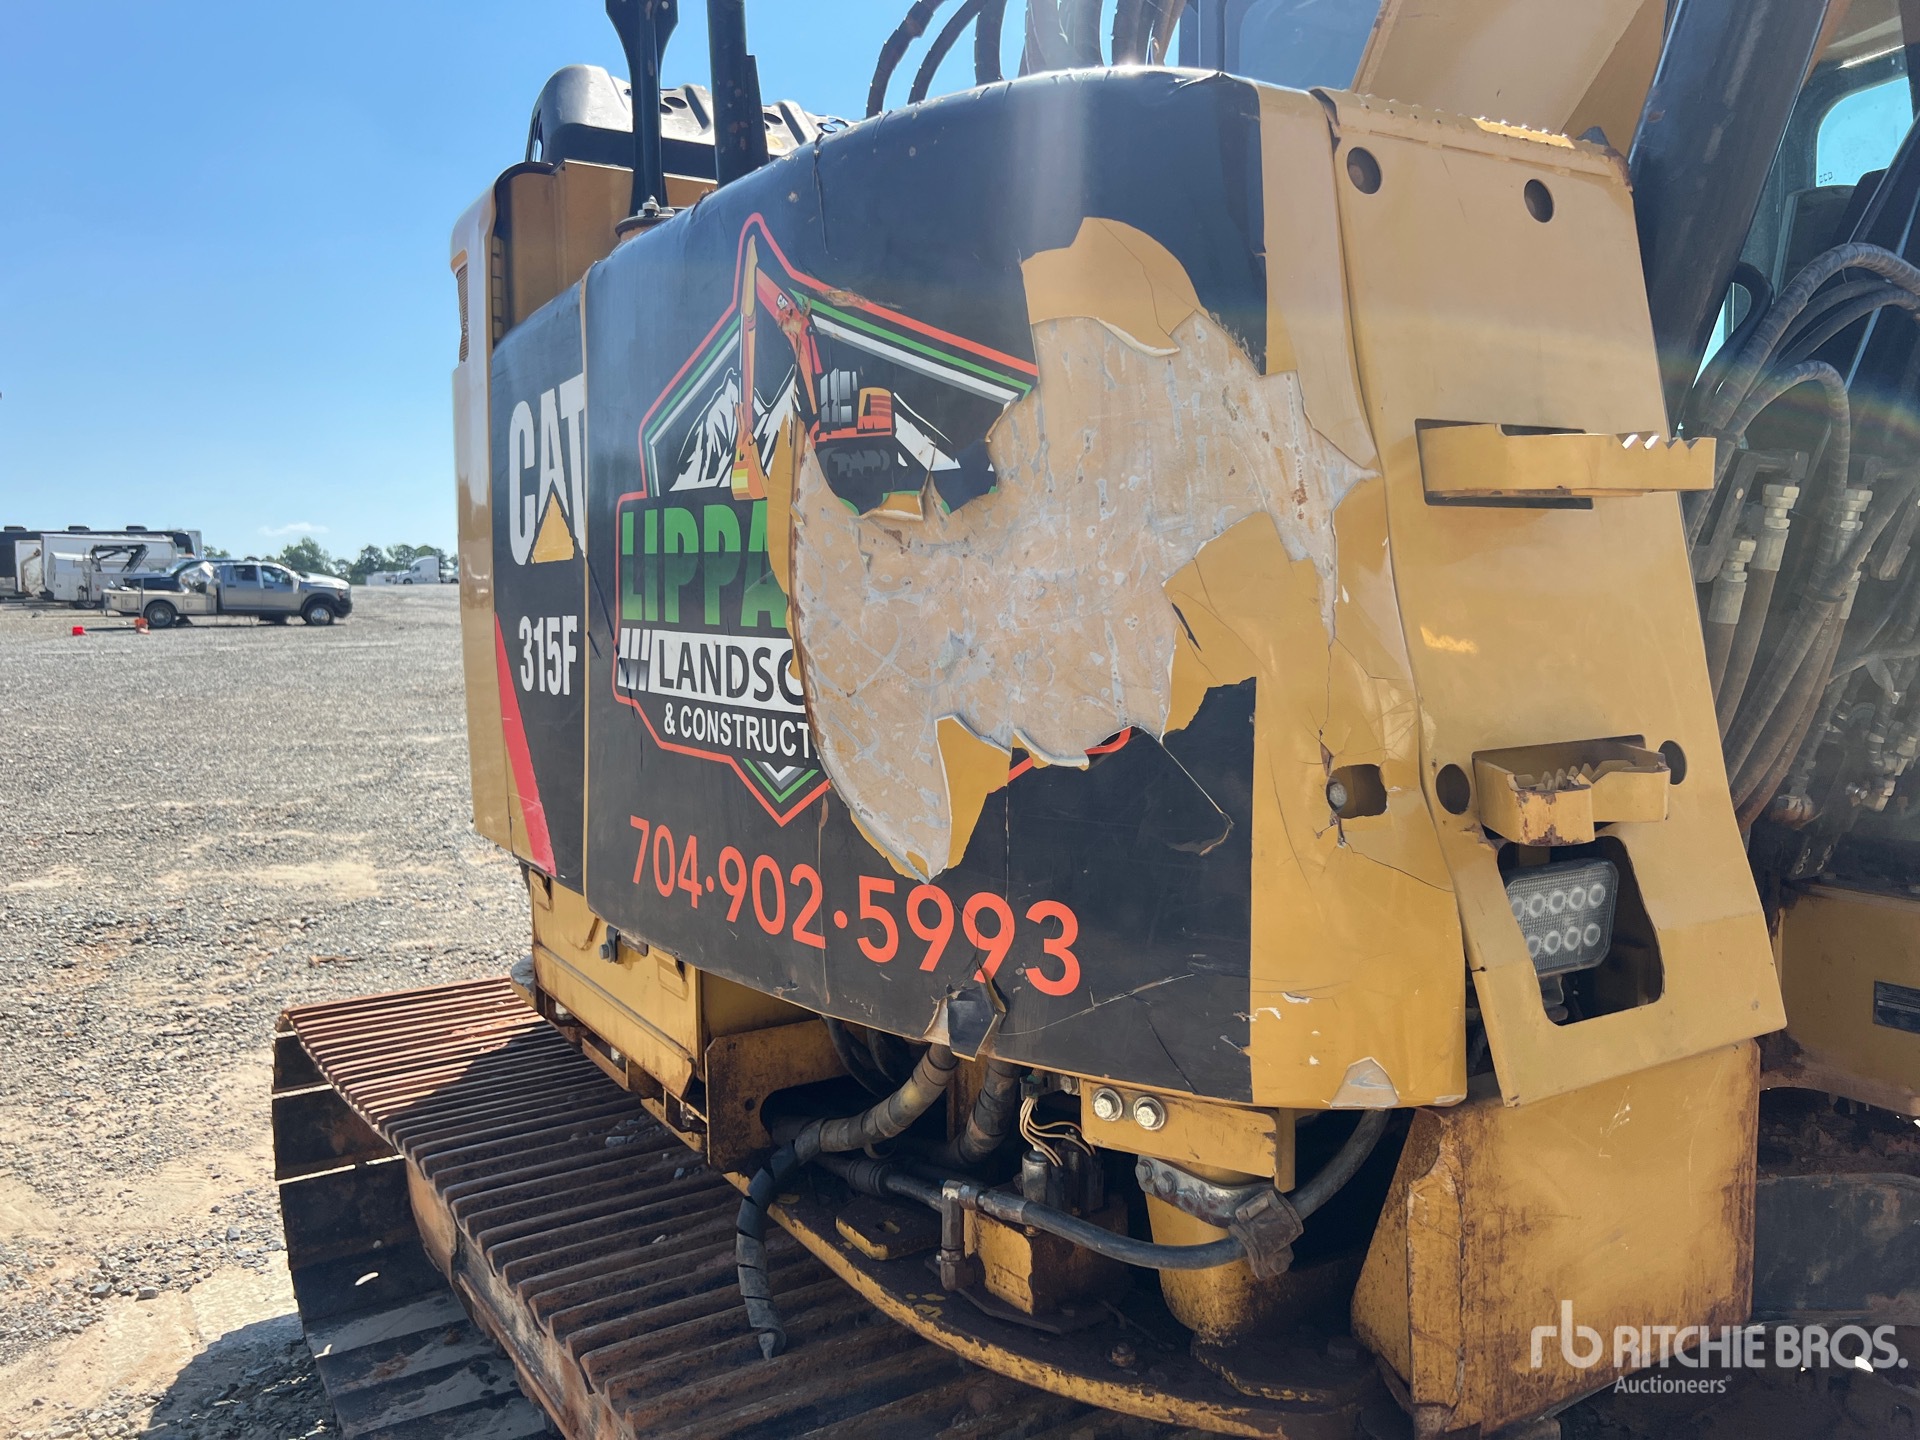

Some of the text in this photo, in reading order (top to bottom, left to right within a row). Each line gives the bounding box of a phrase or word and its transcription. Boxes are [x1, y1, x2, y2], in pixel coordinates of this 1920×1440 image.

[509, 372, 586, 565] CAT
[519, 615, 578, 696] 315F
[664, 702, 820, 760] & CONSTRUCT
